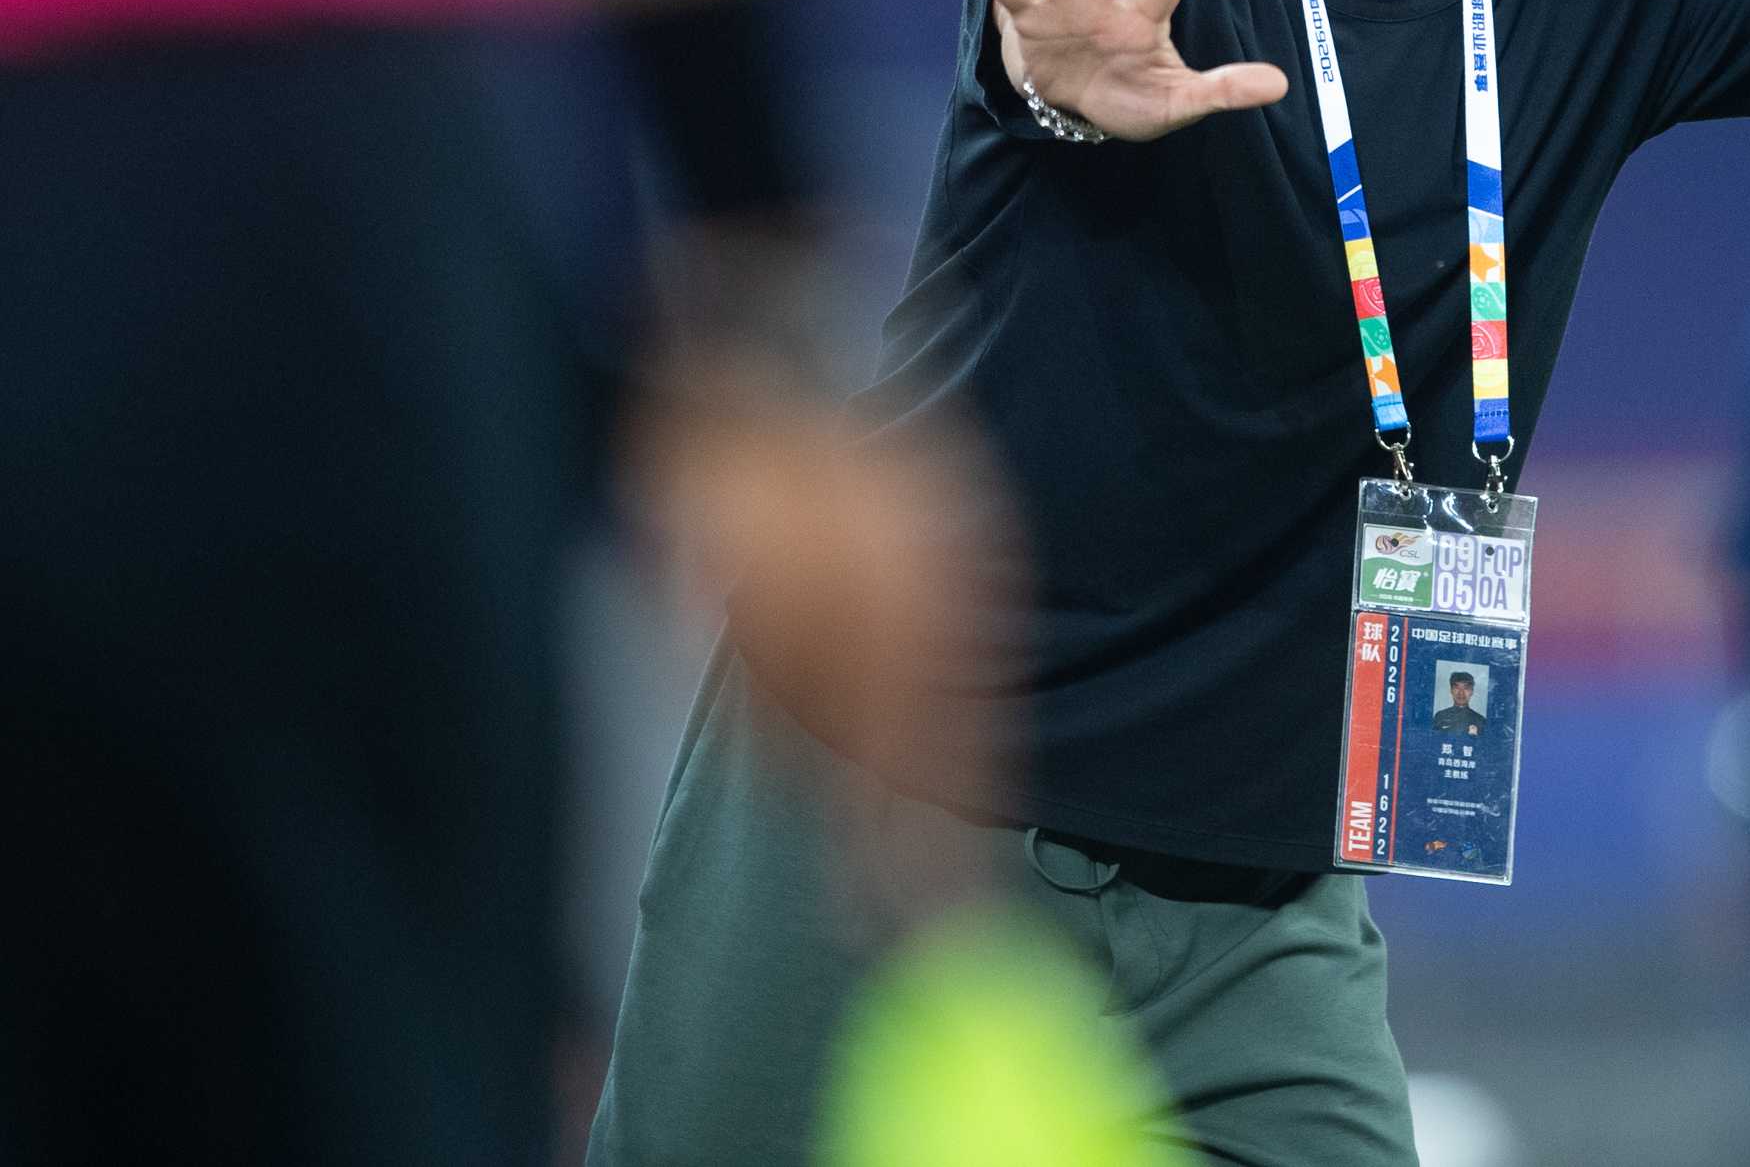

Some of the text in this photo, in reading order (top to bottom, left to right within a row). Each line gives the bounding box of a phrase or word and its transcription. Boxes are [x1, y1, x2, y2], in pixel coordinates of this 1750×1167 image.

[1400, 549, 1420, 559] CSL
[1438, 534, 1475, 573] 09
[1480, 543, 1522, 578] FOP
[1436, 572, 1474, 611] 05
[1361, 621, 1384, 663] 球队
[1411, 627, 1518, 651] 中国足球职业赛事
[1386, 625, 1400, 703] 2026
[1348, 800, 1373, 852] TEAM
[1376, 773, 1390, 855] 1622
